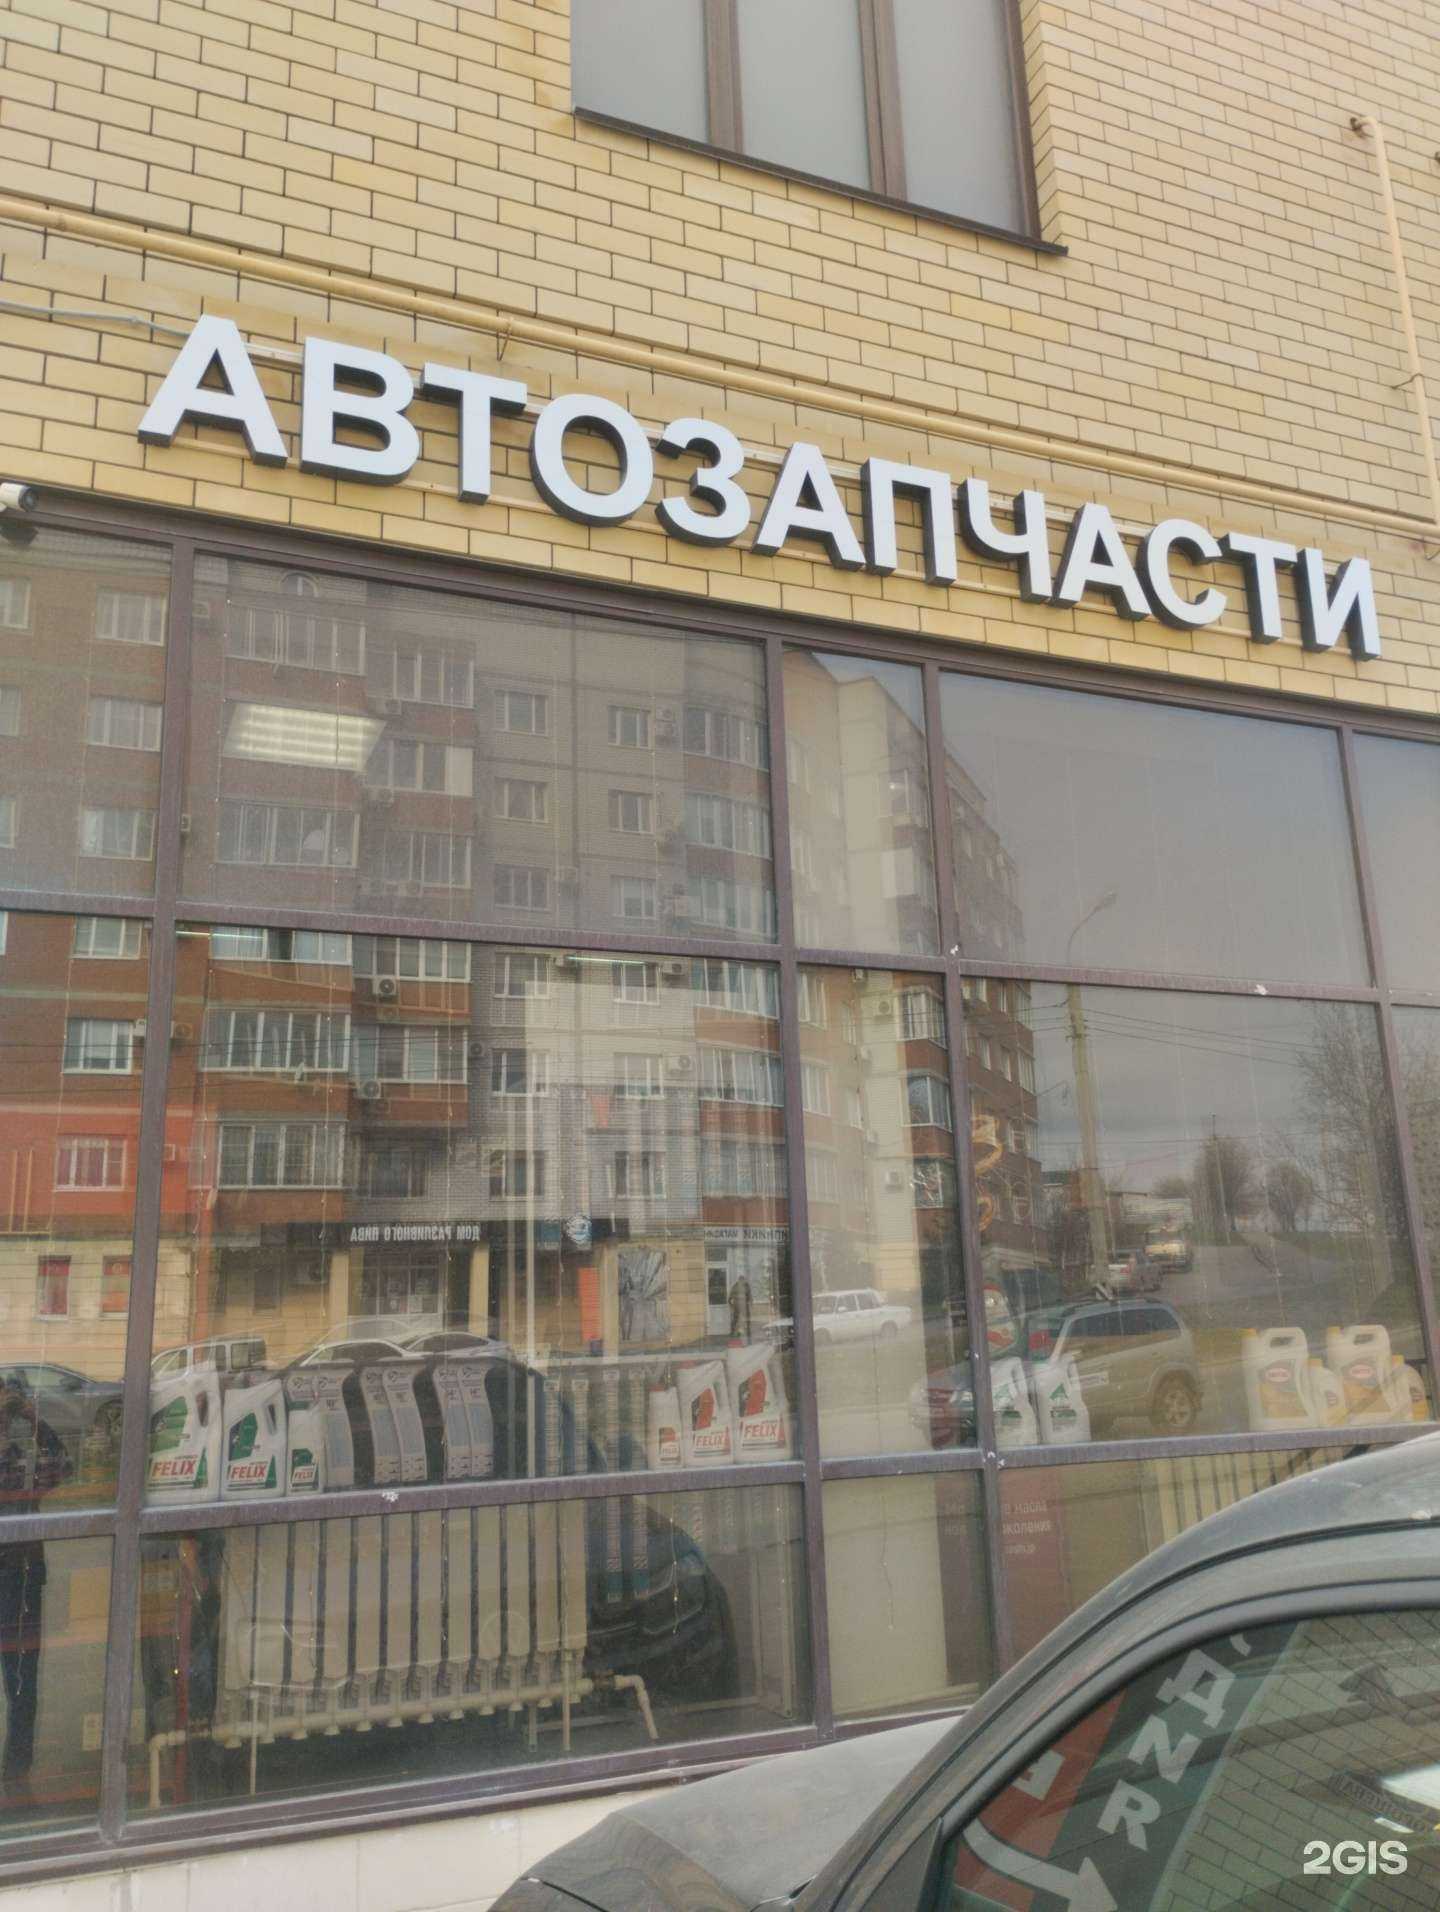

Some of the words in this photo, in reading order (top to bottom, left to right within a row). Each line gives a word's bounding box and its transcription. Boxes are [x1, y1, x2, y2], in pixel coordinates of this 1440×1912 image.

[138, 314, 1380, 661] АВТОЗАПЧАСТИ
[745, 1422, 777, 1438] FELIX
[696, 1435, 723, 1447] FELIX
[152, 1460, 196, 1476] FELIX
[231, 1464, 266, 1480] FELIX
